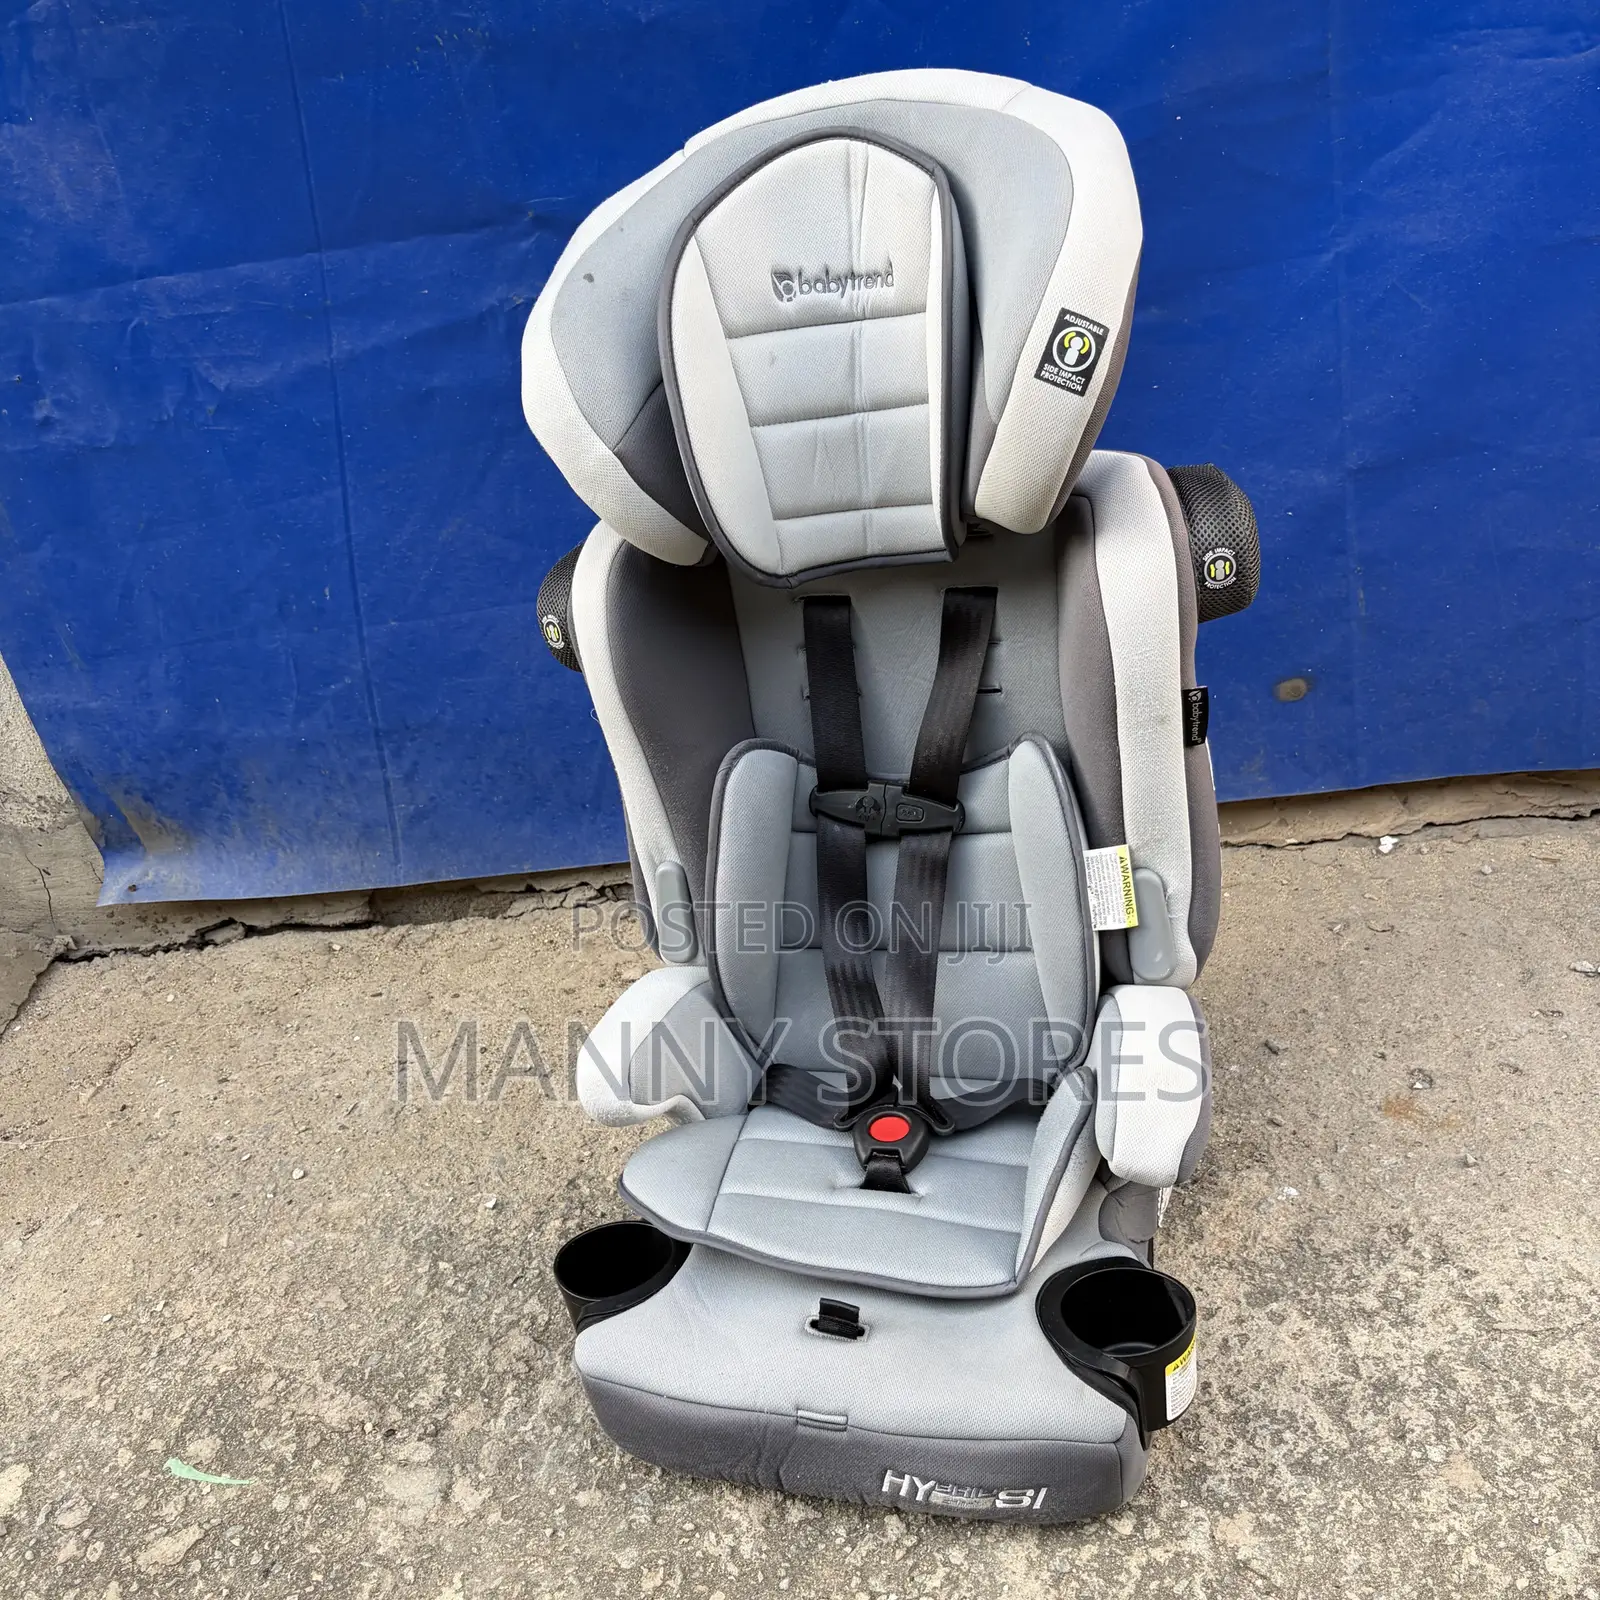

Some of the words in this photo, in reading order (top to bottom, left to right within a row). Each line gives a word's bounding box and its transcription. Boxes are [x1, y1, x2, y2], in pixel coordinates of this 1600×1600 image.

[1063, 314, 1104, 336] ADJUSTABLE
[1040, 370, 1083, 392] PROTECTION
[1043, 363, 1059, 374] SIDE
[1058, 369, 1086, 385] IMPACT
[1214, 547, 1236, 557] IMPACT
